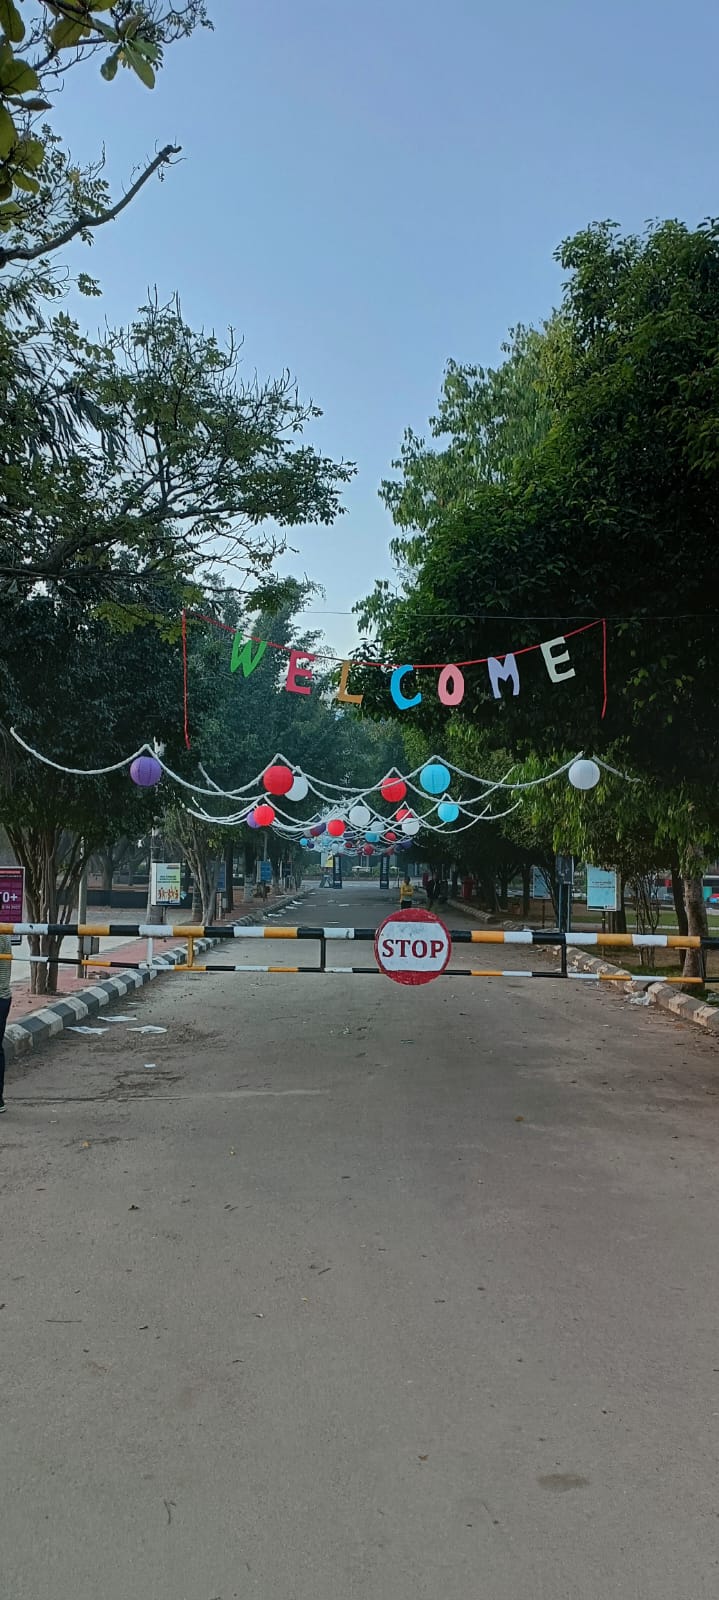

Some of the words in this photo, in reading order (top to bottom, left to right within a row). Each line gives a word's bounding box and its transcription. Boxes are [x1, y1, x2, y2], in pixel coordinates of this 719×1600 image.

[230, 632, 576, 710] WELCOME
[0, 891, 18, 903] 0+
[382, 939, 445, 958] STOP
